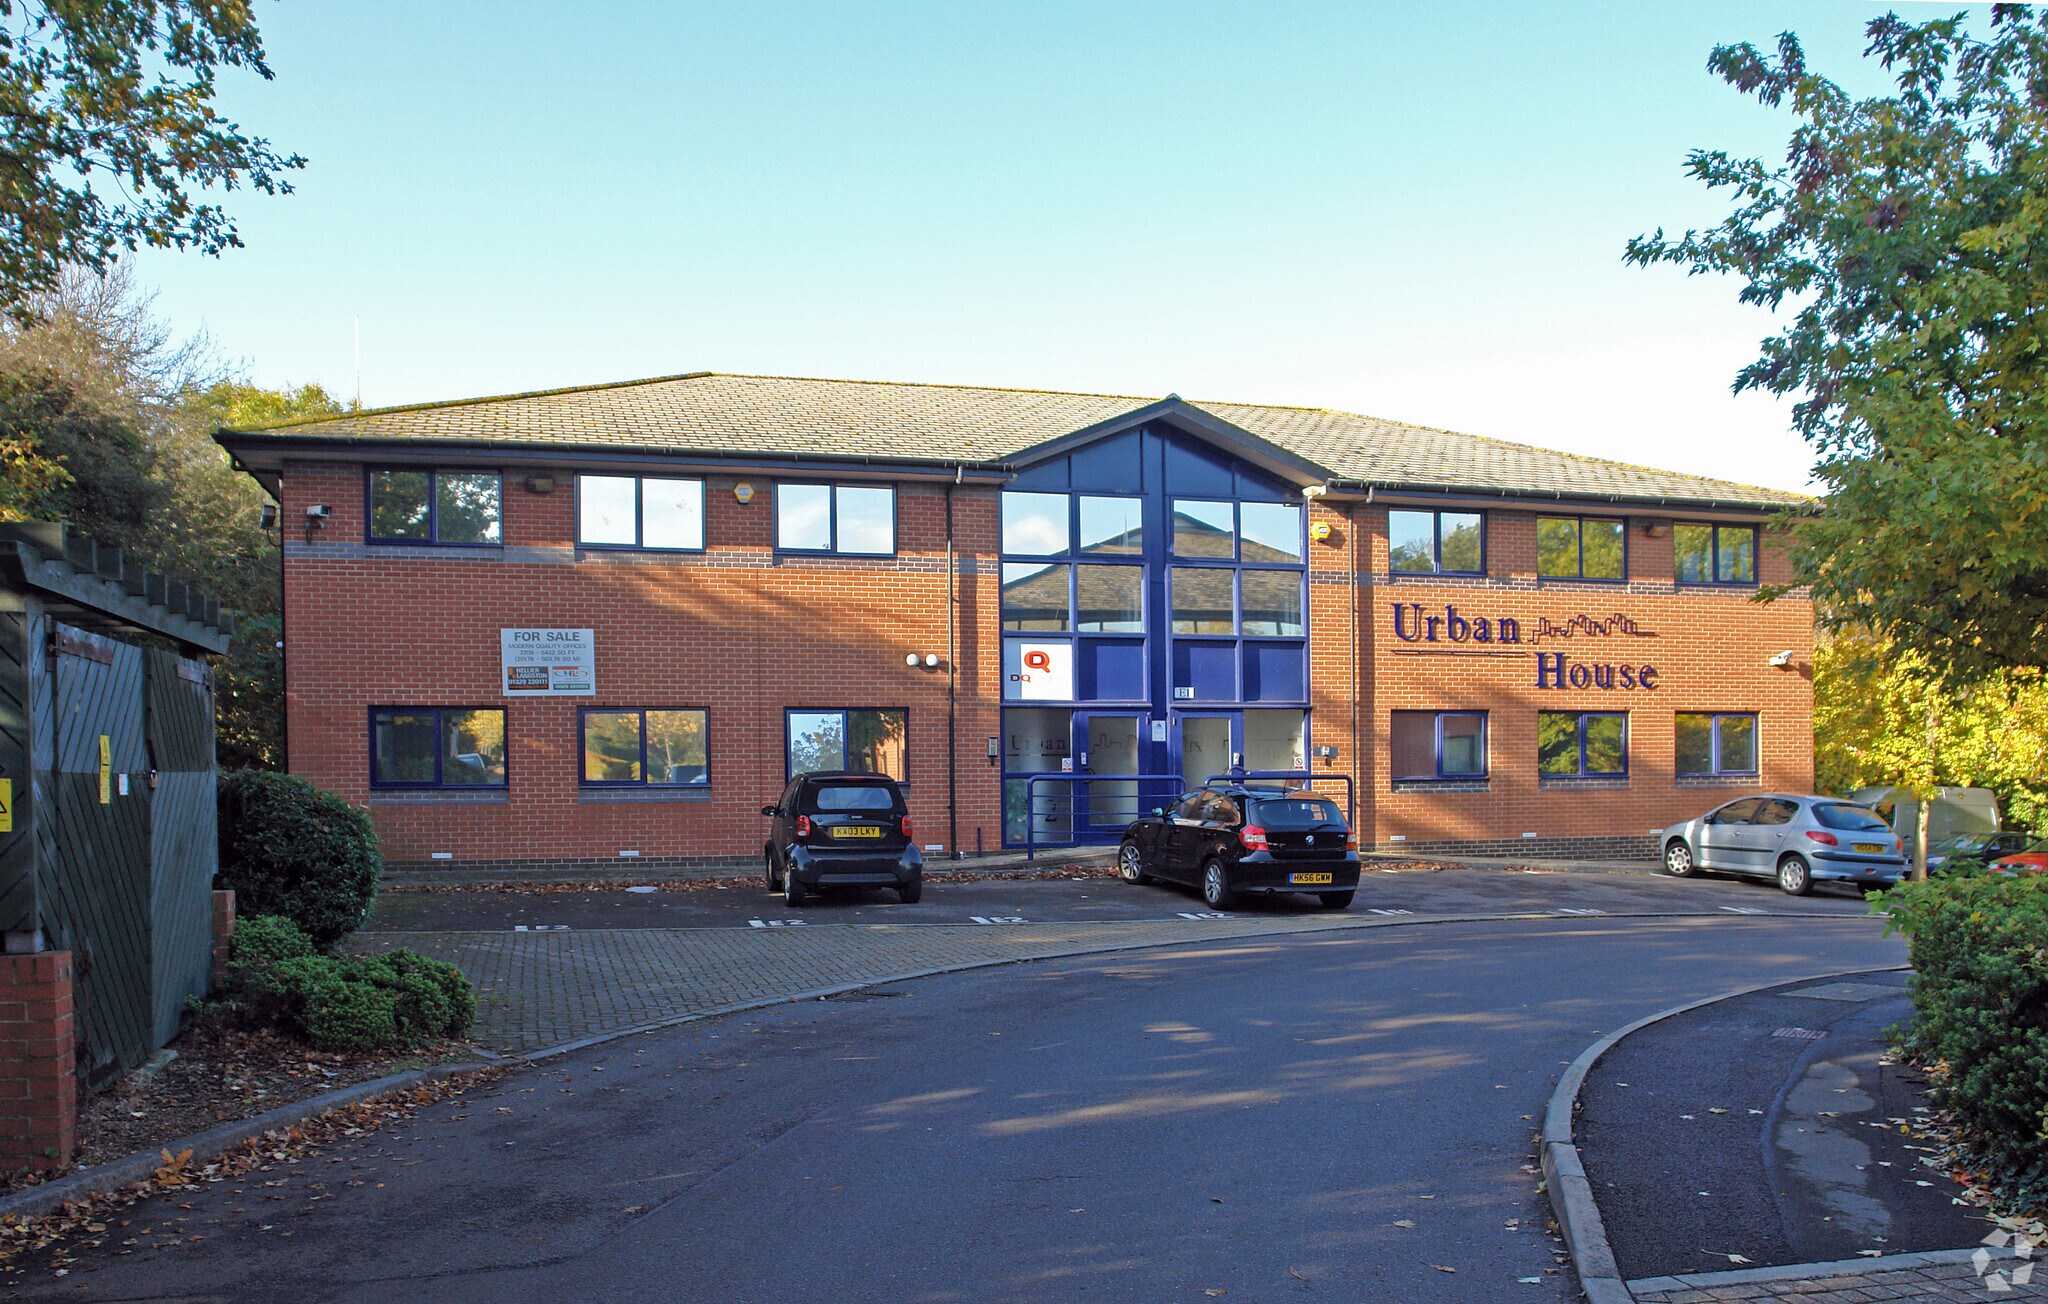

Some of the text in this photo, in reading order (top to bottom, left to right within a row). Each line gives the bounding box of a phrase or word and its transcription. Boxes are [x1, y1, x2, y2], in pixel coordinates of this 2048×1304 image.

[1390, 603, 1521, 642] Urban
[514, 631, 580, 641] FOR SALE
[1535, 652, 1659, 689] House
[1010, 674, 1031, 683] DQ
[836, 827, 876, 836] KX03 LKY
[1293, 873, 1314, 882] HK56
